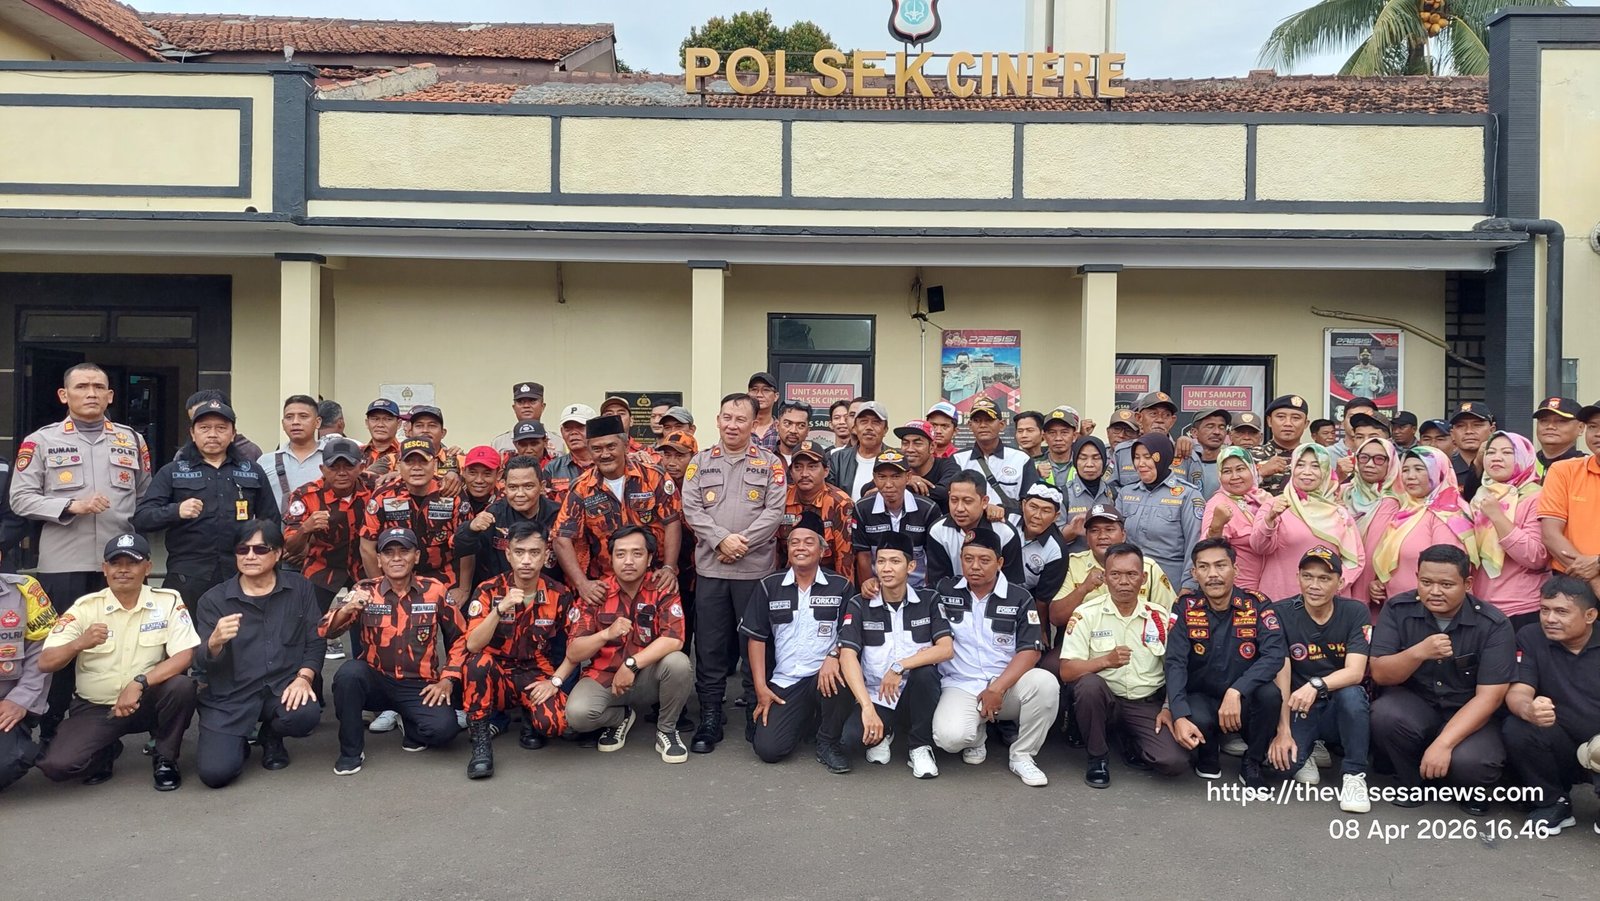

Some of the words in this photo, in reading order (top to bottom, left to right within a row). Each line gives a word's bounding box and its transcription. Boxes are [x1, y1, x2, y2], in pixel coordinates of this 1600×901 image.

[684, 46, 935, 97] POLSEK
[946, 51, 1127, 98] CINERE
[968, 335, 1017, 343] PRESISI
[570, 406, 578, 414] P
[403, 439, 429, 449] RESCUE
[110, 447, 135, 457] POLRI
[746, 467, 768, 475] POLRI
